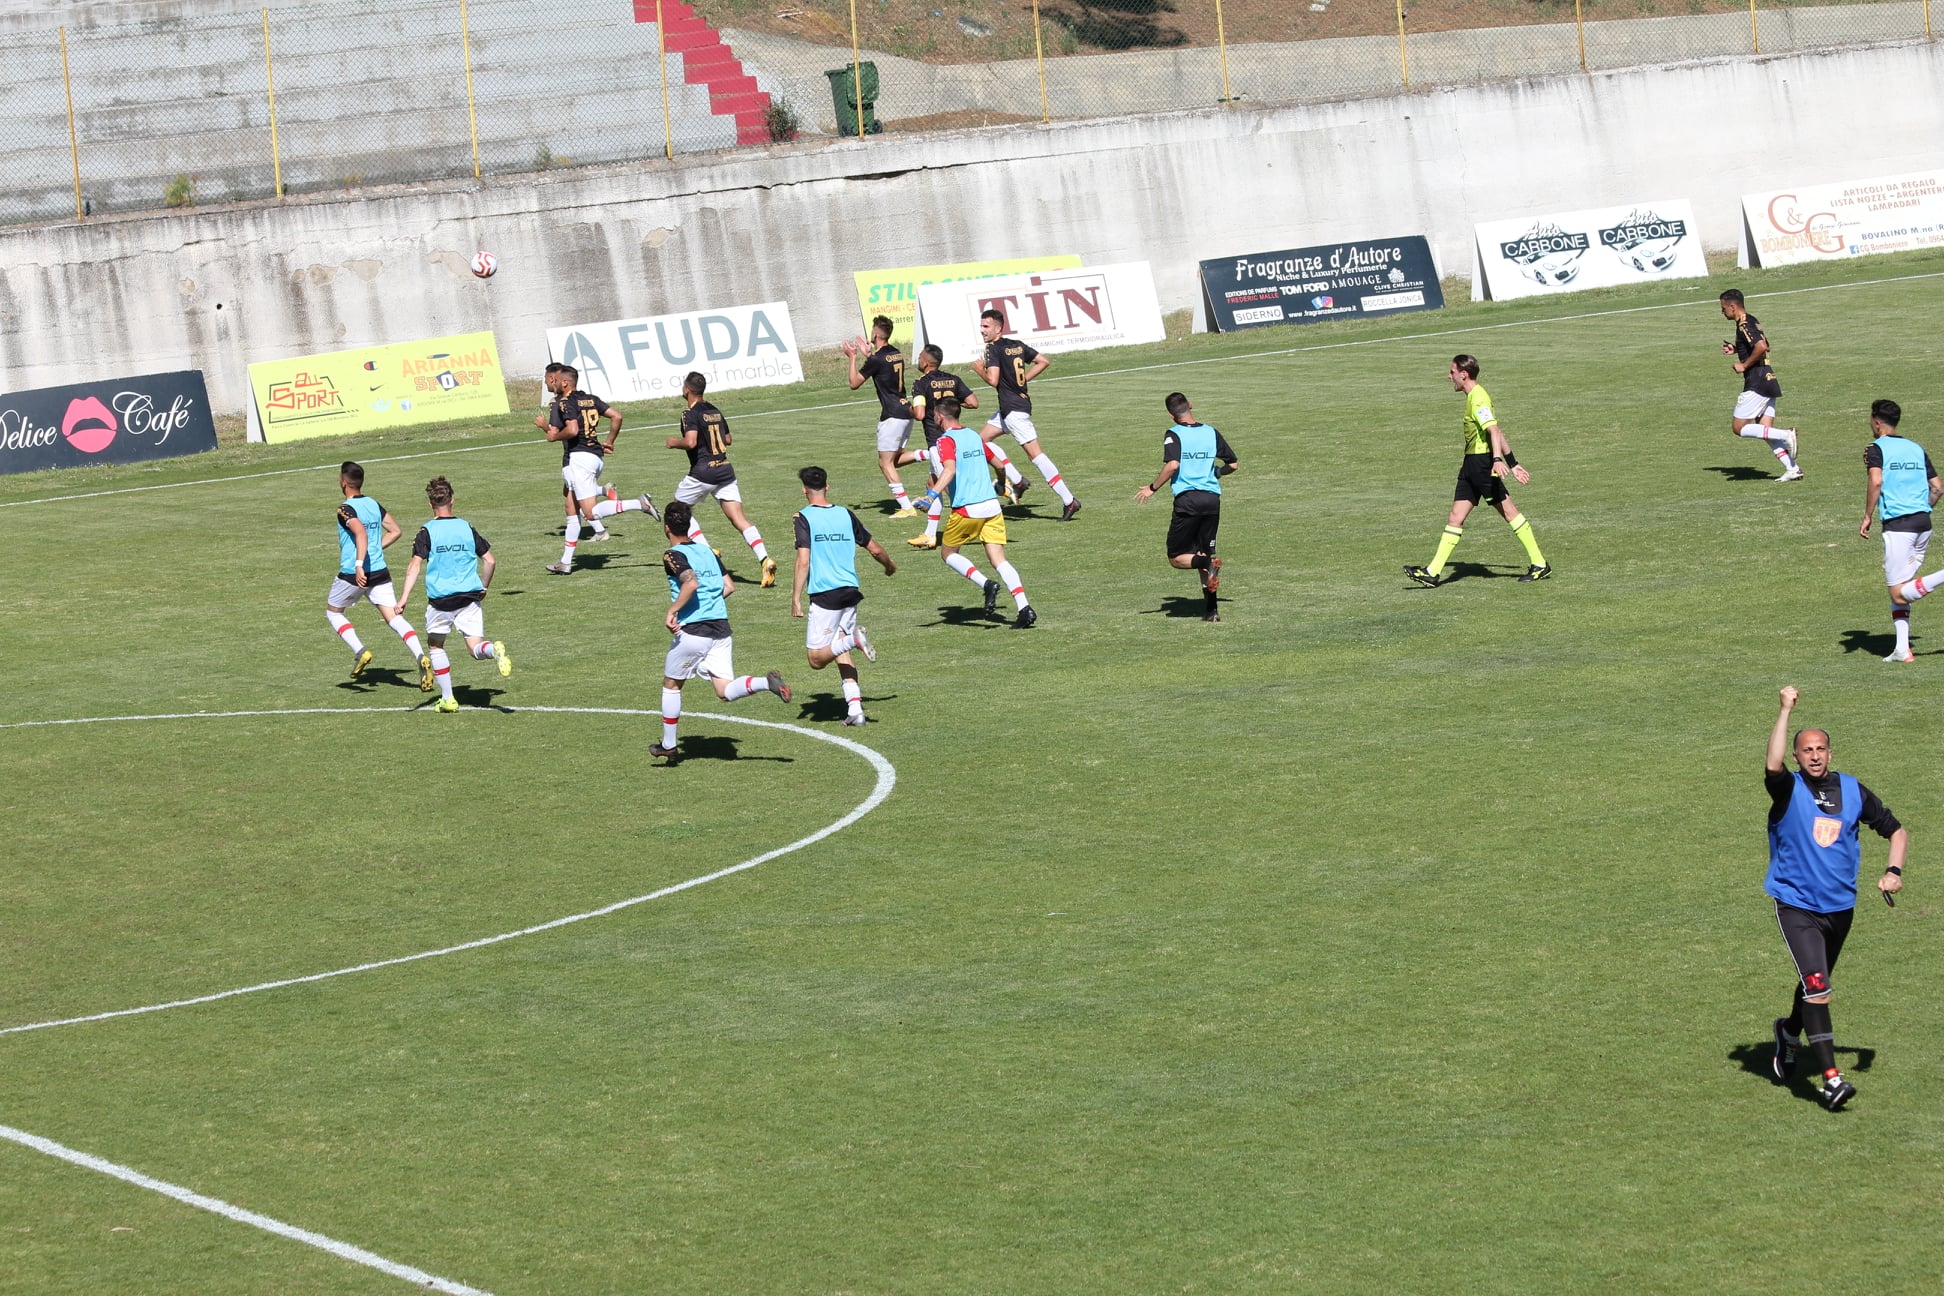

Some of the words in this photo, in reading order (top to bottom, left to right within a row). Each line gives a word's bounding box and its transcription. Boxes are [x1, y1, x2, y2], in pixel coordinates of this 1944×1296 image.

[1843, 185, 1884, 197] ARTICOLI
[1901, 179, 1936, 189] REGALO
[1830, 199, 1854, 207] LISTA
[1857, 193, 1887, 203] NOZZE
[1868, 199, 1921, 212] LAMPADARI
[1621, 207, 1660, 227] Auto
[1523, 220, 1564, 241] Auto
[1861, 228, 1908, 240] BOVALINO
[1760, 230, 1833, 254] BOMBONIERE
[1235, 255, 1323, 281] Fragranze
[1330, 246, 1402, 271] d'Autore
[1276, 272, 1300, 282] Niche
[1302, 271, 1309, 279] &
[1310, 268, 1339, 278] Luxury
[1341, 263, 1388, 275] Perfumerie
[1280, 283, 1303, 296] TOM
[1302, 281, 1330, 294] FORD
[1332, 274, 1382, 289] AMOUAGE
[1374, 283, 1391, 291] CLIVE
[1392, 280, 1424, 288] CHRISTIAN
[870, 303, 900, 315] MANGIMI
[977, 277, 1104, 336] TIN
[1363, 297, 1397, 307] ROCCELLA
[1400, 293, 1422, 304] JONICA
[1236, 309, 1281, 322] SIDERNO
[618, 310, 789, 371] FUDA
[401, 347, 494, 379] ARIANNA
[1012, 357, 1026, 387] 6
[413, 369, 484, 392] SPORT
[632, 375, 663, 393] the
[702, 363, 719, 385] of
[726, 357, 794, 384] marble
[893, 362, 905, 393] 7
[265, 386, 340, 410] SPORT
[112, 391, 193, 446] Café
[707, 424, 727, 456] 11
[1182, 451, 1216, 459] EVOL
[1889, 461, 1925, 470] EVOL
[814, 533, 851, 542] EVOL
[436, 544, 470, 553] EVOL
